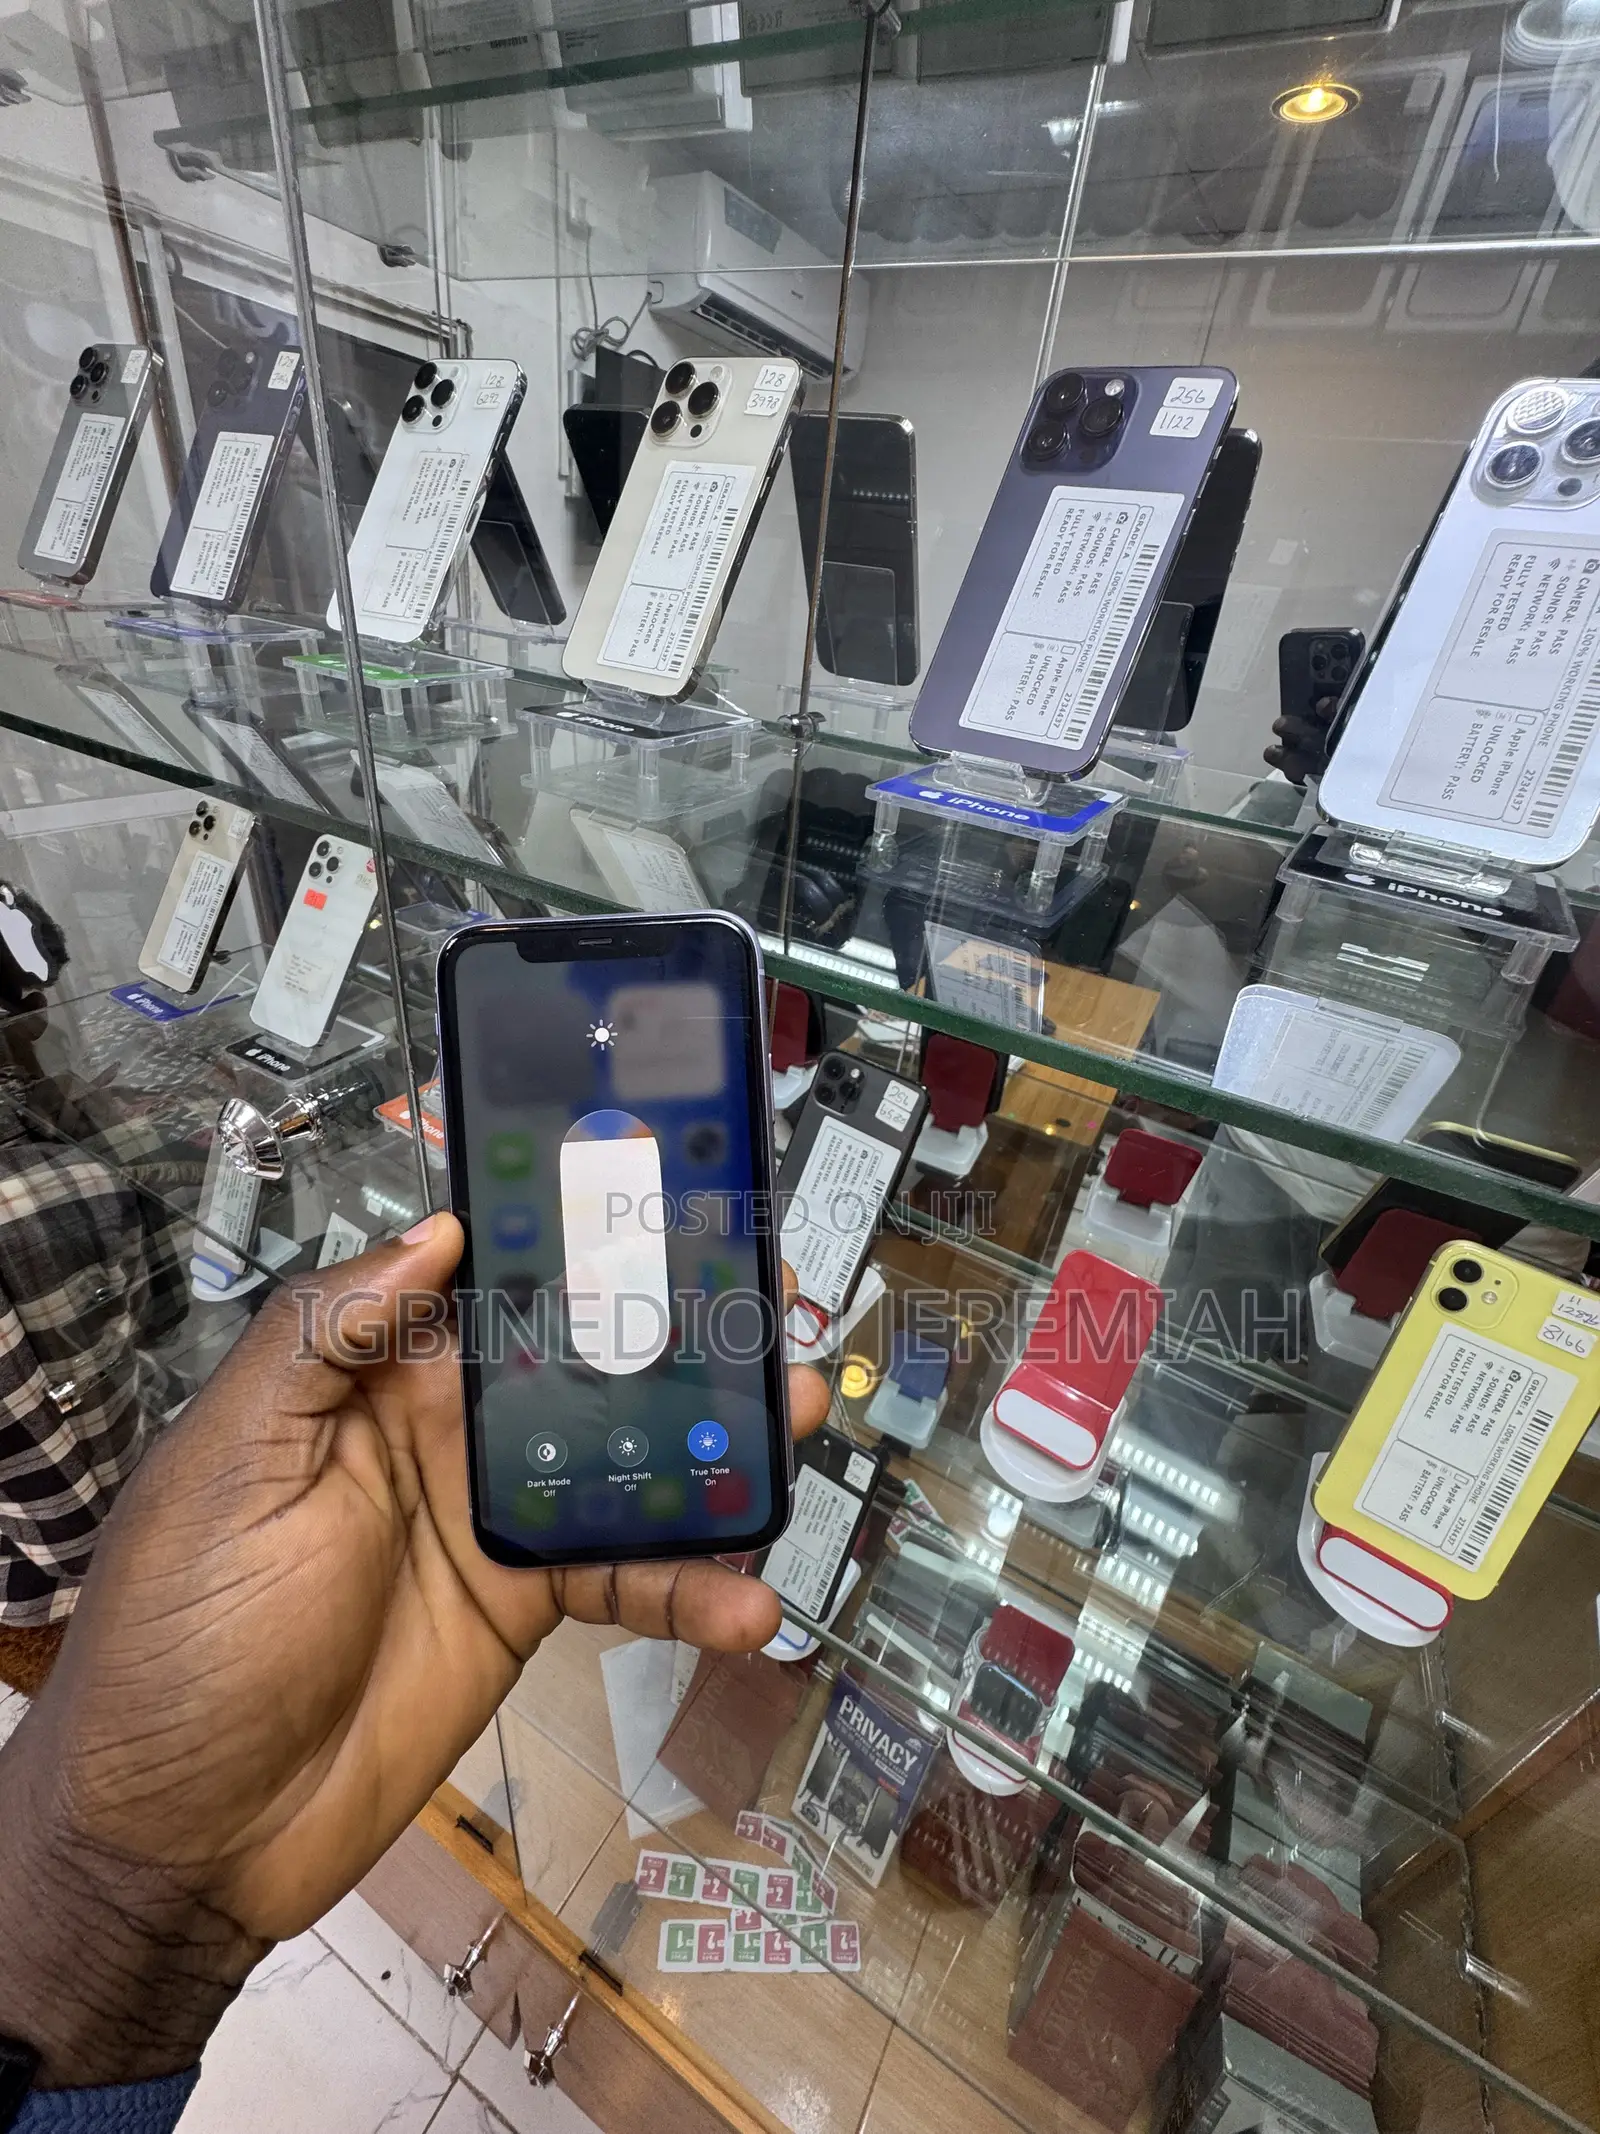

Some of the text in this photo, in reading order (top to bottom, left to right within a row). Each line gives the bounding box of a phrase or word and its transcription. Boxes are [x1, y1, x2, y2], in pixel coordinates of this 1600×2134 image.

[486, 372, 504, 388] 128
[760, 369, 786, 387] 128
[1170, 386, 1205, 404] 256
[1160, 411, 1194, 430] 1122
[1031, 507, 1074, 598] READY FOR RESALE
[1051, 508, 1084, 575] FULLY TESTED
[1056, 524, 1095, 604] NETWORK: PASS
[1072, 525, 1107, 597] SOUNDS: PASS
[1087, 526, 1121, 595] CAMERA: PASS
[1469, 553, 1521, 657] READY FOR RESALE
[1496, 554, 1536, 631] FULLY TESTED
[1526, 575, 1569, 657] SOUNDS: PASS
[1547, 576, 1590, 655] CAMERA: PASS
[1051, 512, 1147, 728] GRADE: A 100% WORKING PHONE 2734437
[1505, 573, 1552, 665] NETWORK: PASS
[1003, 653, 1038, 721] BATTERY: PASS
[1025, 654, 1052, 706] UNLOCKED
[1038, 656, 1068, 716] Apple iPhone
[1509, 626, 1597, 812] 100% WORKING PHONE 2734437
[1440, 722, 1482, 801] BATTERY: PASS
[1469, 724, 1502, 784] UNLOCKED
[1488, 727, 1526, 797] Apple iPhone
[947, 797, 1030, 821] iPhone
[1388, 882, 1503, 916] iPhone
[135, 996, 164, 1014] iPhone
[257, 1053, 291, 1072] iPhone
[1542, 1324, 1586, 1354] 8166
[1423, 1346, 1465, 1419] READY FOR RESALE
[1443, 1350, 1476, 1406] FULLY TESTED
[1448, 1369, 1486, 1434] NETWORK: PASS
[1464, 1375, 1499, 1433] SOUNDS: PASS
[1479, 1381, 1513, 1437] CAMERA: PASS
[527, 1478, 571, 1488] Dark Mode
[608, 1472, 652, 1484] Night Shift
[690, 1467, 730, 1476] True Tone
[705, 1478, 717, 1487] On
[1446, 1378, 1539, 1546] GRADE: A 100% WORKING PHONE 2734437
[543, 1490, 556, 1498] Off
[624, 1484, 637, 1492] Off
[1398, 1468, 1430, 1522] BATTERY: PASS
[1419, 1475, 1445, 1516] UNLOCKED
[1431, 1482, 1461, 1530] Apple iPhone
[838, 1695, 918, 1772] PRIVACY
[647, 1869, 657, 1885] 2
[679, 1875, 685, 1891] 1
[711, 1879, 720, 1895] 2
[775, 1886, 783, 1903] 2
[806, 1891, 812, 1907] 1
[677, 1930, 684, 1949] 1
[706, 1931, 715, 1949] 2
[773, 1933, 782, 1950] 2
[840, 1932, 848, 1950] 2
